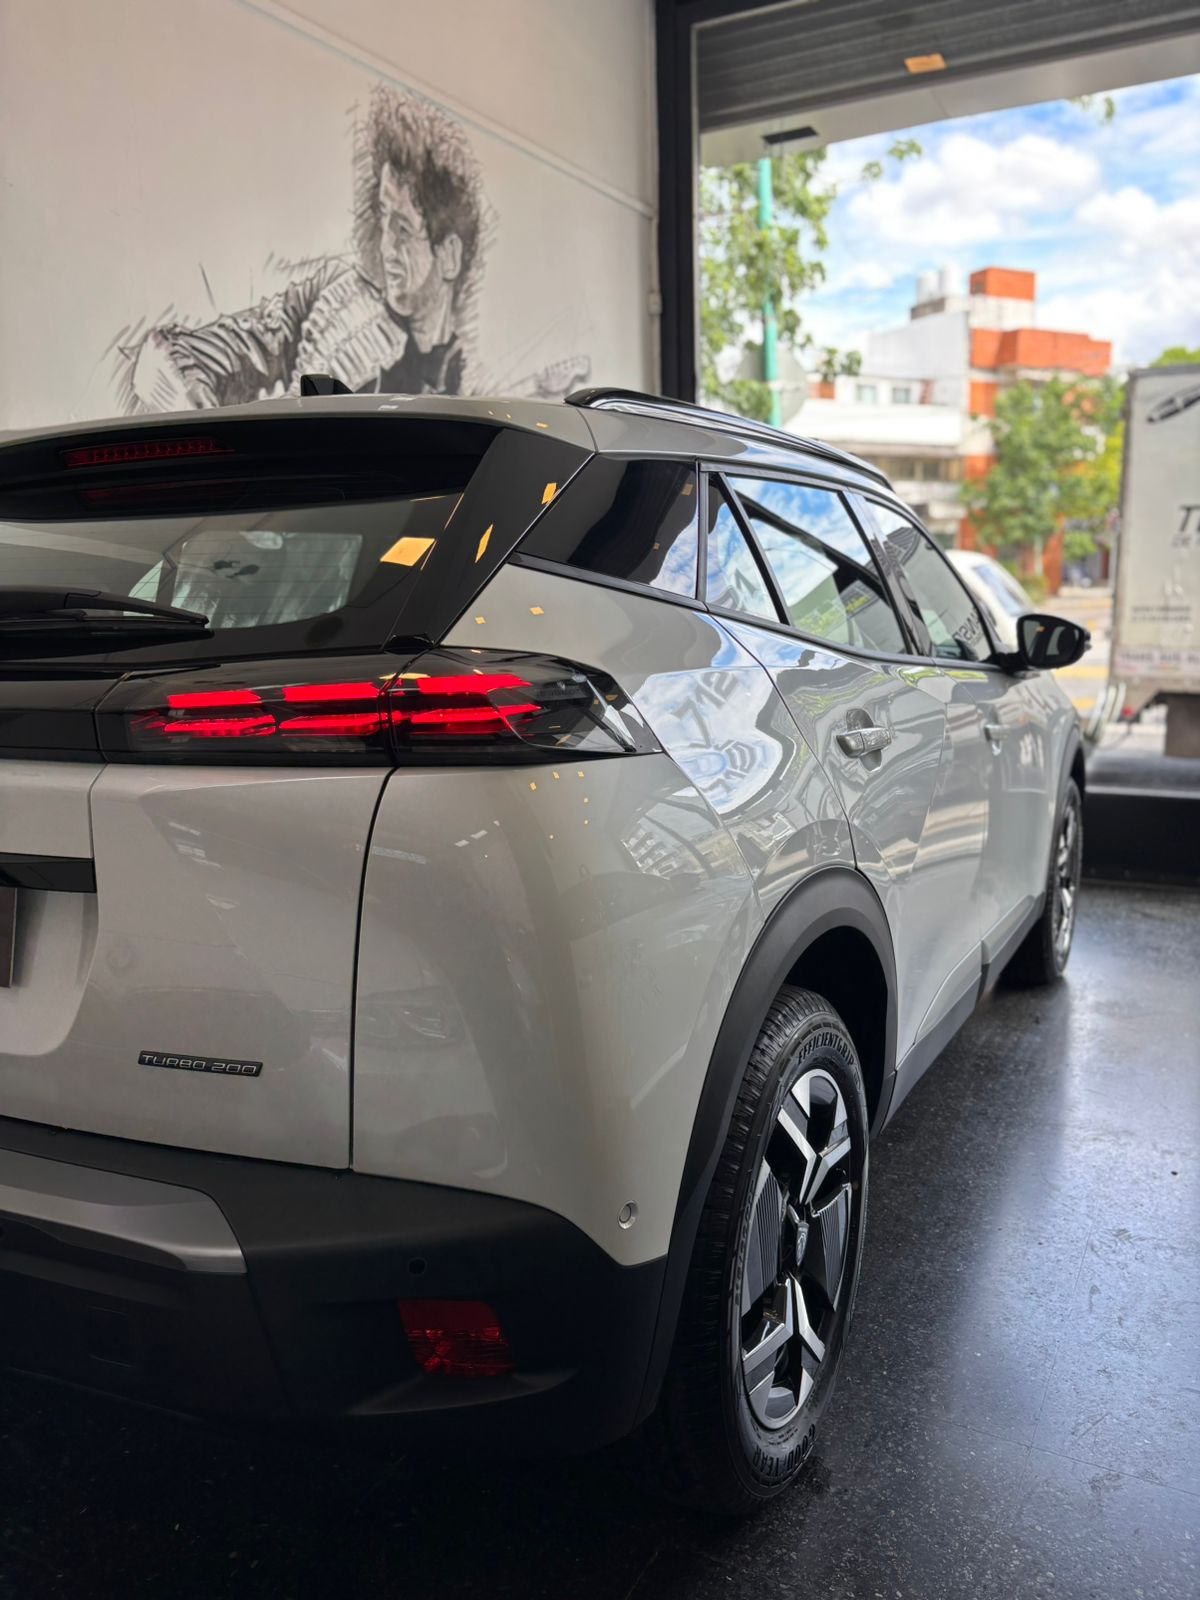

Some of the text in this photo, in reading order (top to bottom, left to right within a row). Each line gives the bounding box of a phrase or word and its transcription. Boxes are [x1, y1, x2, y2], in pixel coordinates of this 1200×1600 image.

[798, 1031, 855, 1065] EFFICIENTGRIP
[142, 1055, 257, 1074] TURBO 200
